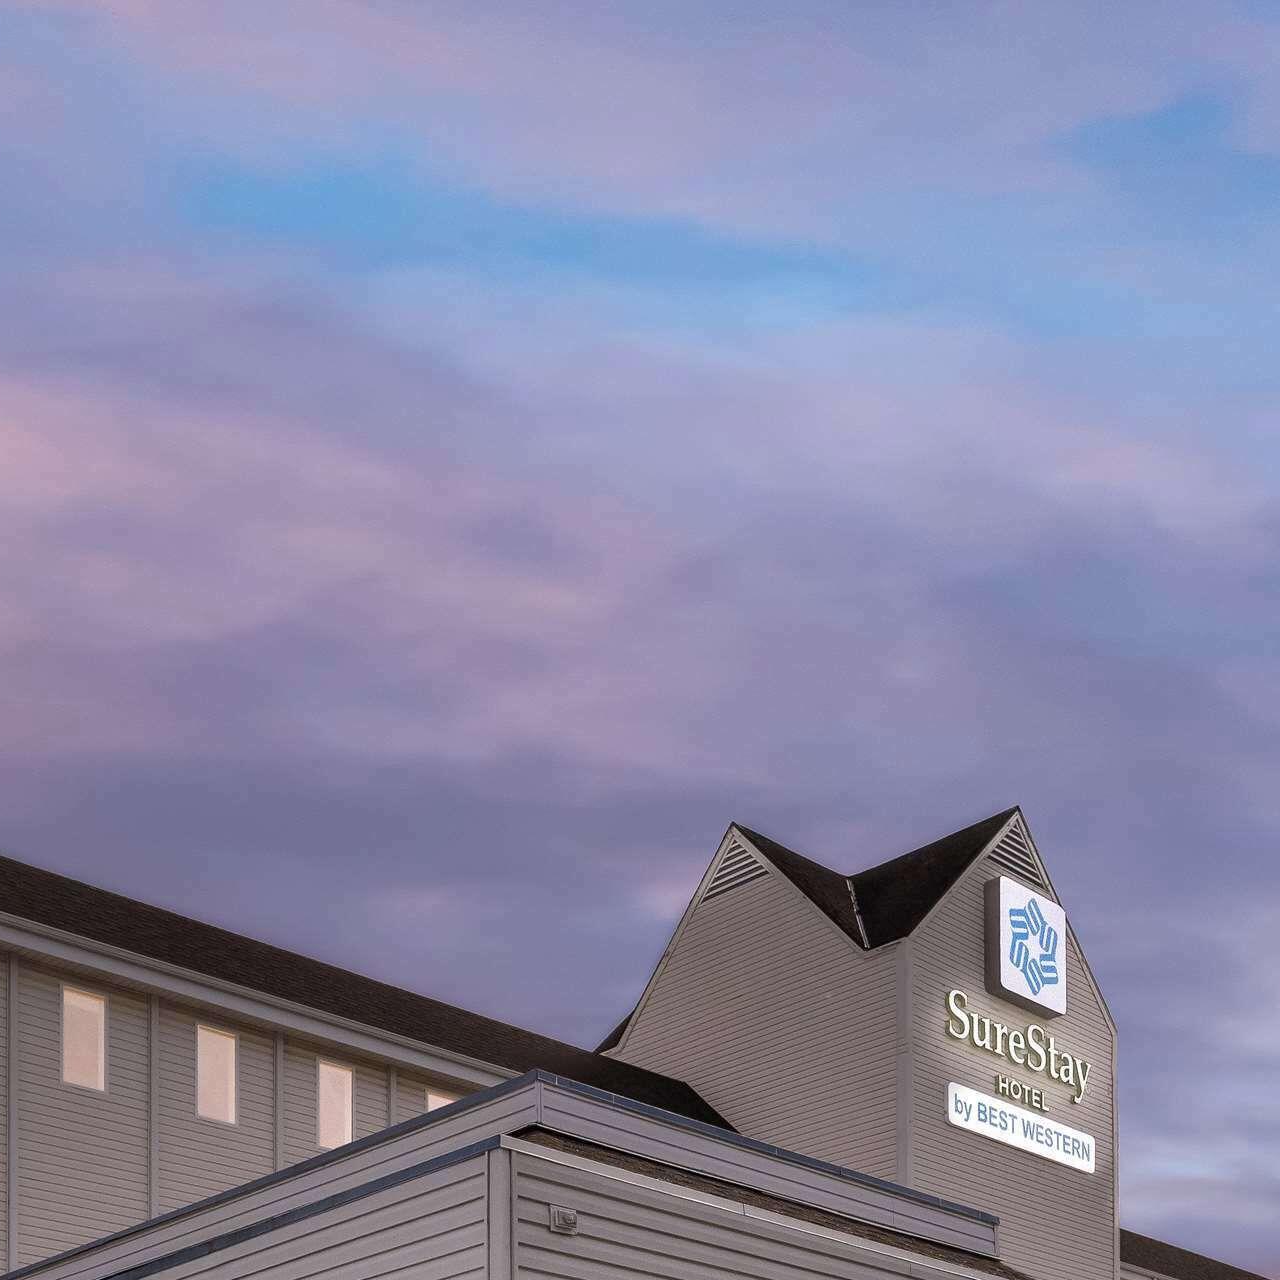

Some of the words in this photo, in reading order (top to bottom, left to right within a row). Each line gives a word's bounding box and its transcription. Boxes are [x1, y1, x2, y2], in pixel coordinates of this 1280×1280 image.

[947, 989, 1091, 1103] SureStay
[997, 1074, 1049, 1111] HOTEL
[954, 1093, 972, 1122] by
[978, 1103, 1017, 1134] BEST
[1021, 1118, 1091, 1161] WESTERN
